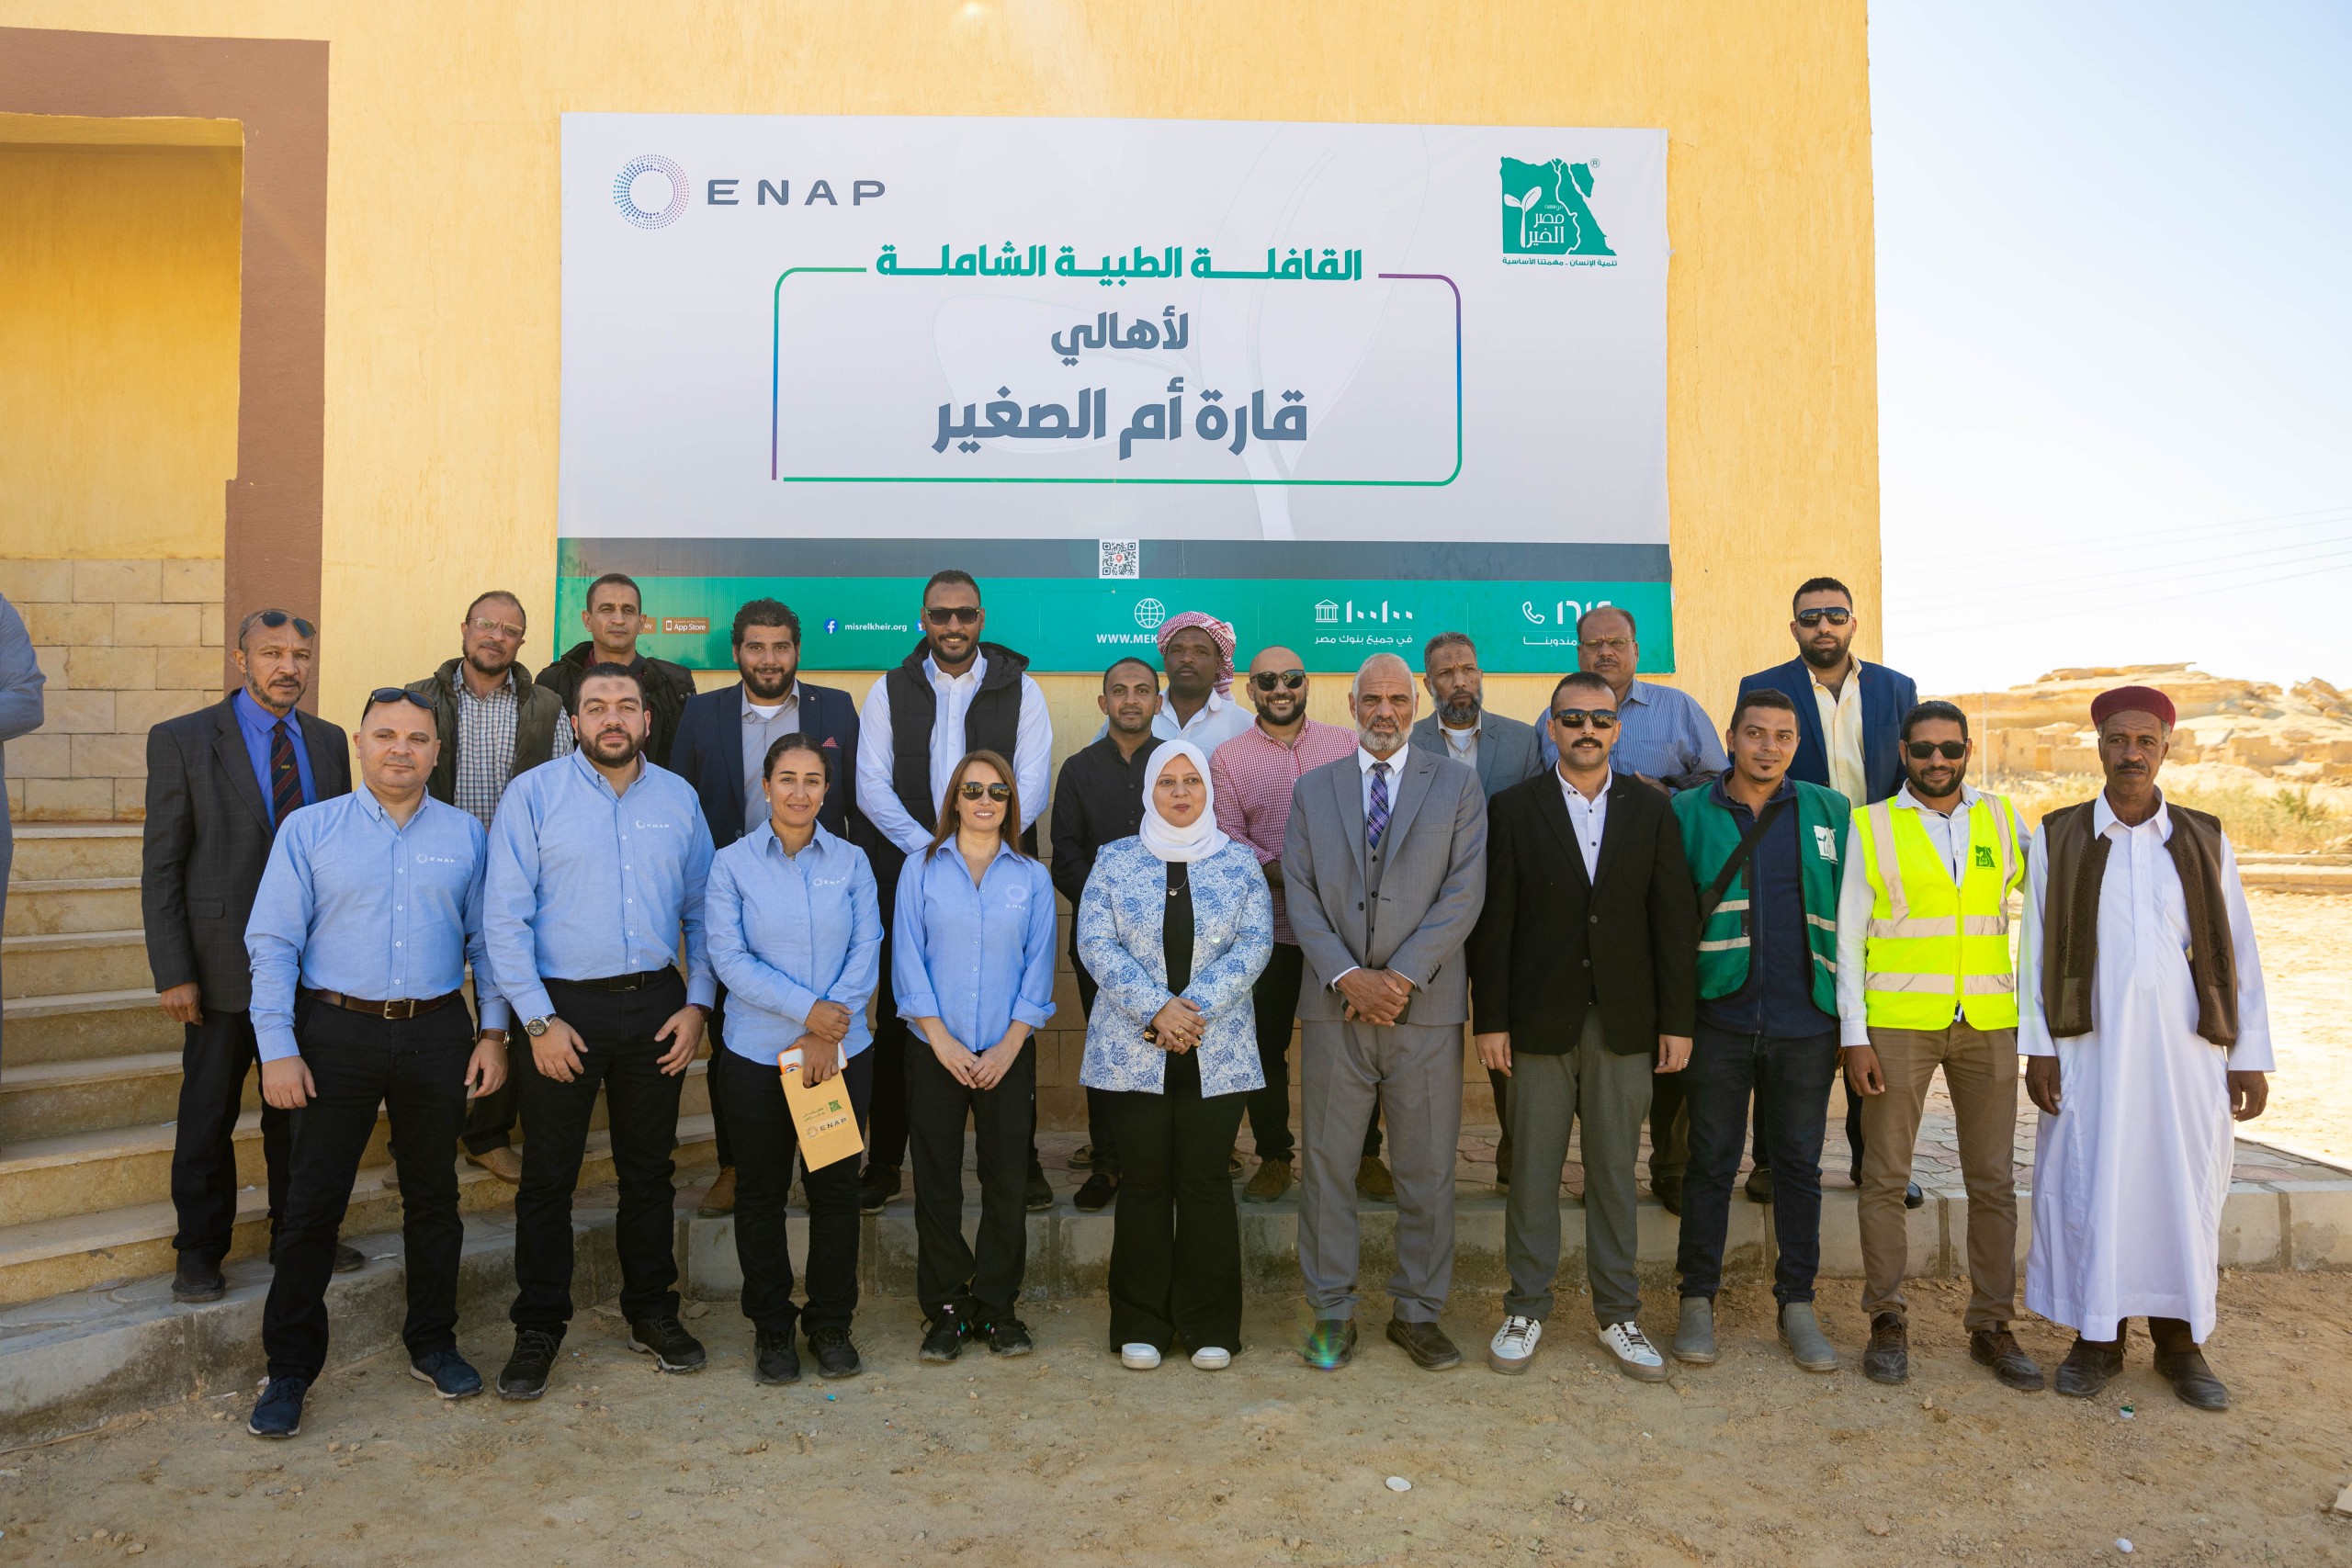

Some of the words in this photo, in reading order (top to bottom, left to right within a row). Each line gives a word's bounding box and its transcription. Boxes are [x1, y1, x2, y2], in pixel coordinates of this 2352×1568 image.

[707, 179, 887, 207] ENAP
[1533, 213, 1565, 229] مصر
[1526, 226, 1565, 248] الخير
[1537, 258, 1564, 266] مهمتنا
[1597, 258, 1618, 267] تنمية
[1050, 305, 1189, 367] لأهالي
[931, 385, 1106, 455] الصغير
[1119, 376, 1184, 461] أم
[1195, 389, 1307, 457] قارة
[673, 624, 688, 632] App
[844, 622, 908, 633] misrelkheir.org
[1096, 634, 1158, 644] WWW.MEK
[1315, 637, 1337, 645] مصر
[1339, 635, 1364, 646] بنوك
[1366, 635, 1394, 646] جميع
[1396, 635, 1413, 647] في
[820, 1117, 847, 1131] ENAP
